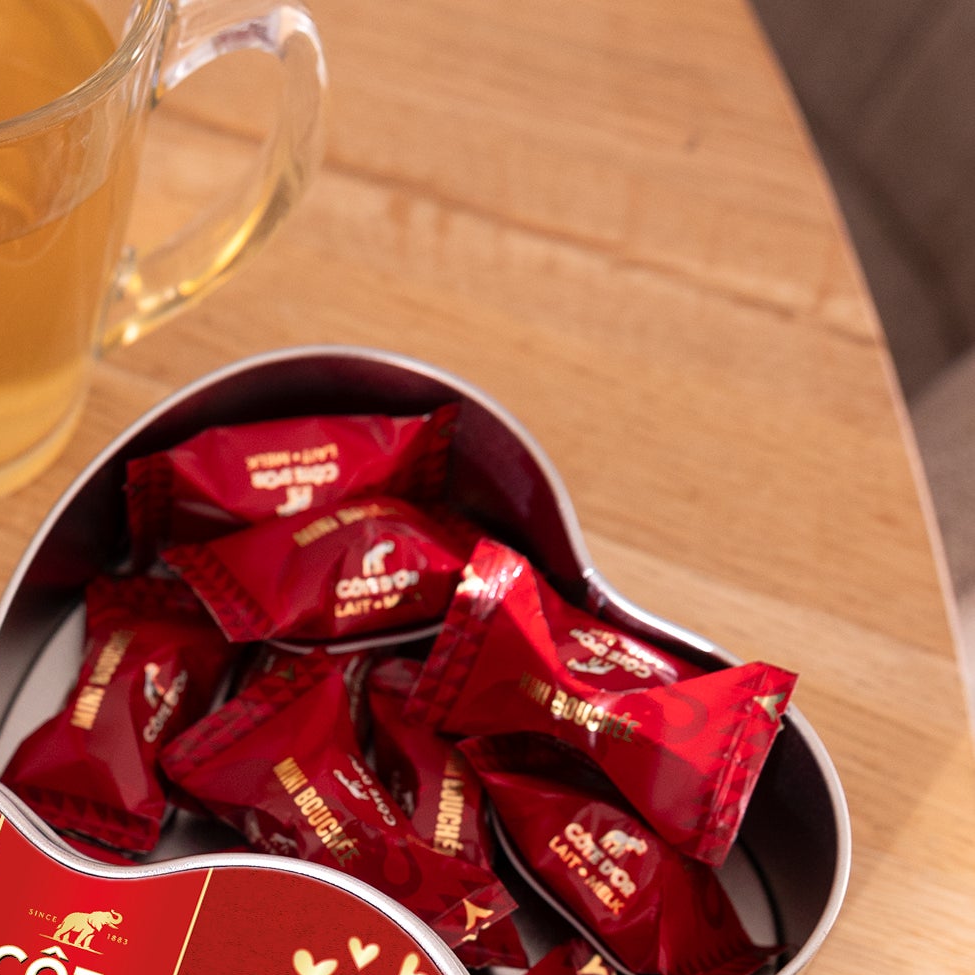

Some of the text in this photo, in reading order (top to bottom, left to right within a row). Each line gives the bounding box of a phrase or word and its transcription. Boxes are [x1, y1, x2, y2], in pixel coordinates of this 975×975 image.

[549, 689, 642, 744] BOUCHÉE
[548, 835, 583, 870] LAIT
[28, 908, 58, 923] SINCE
[106, 932, 129, 946] 1883
